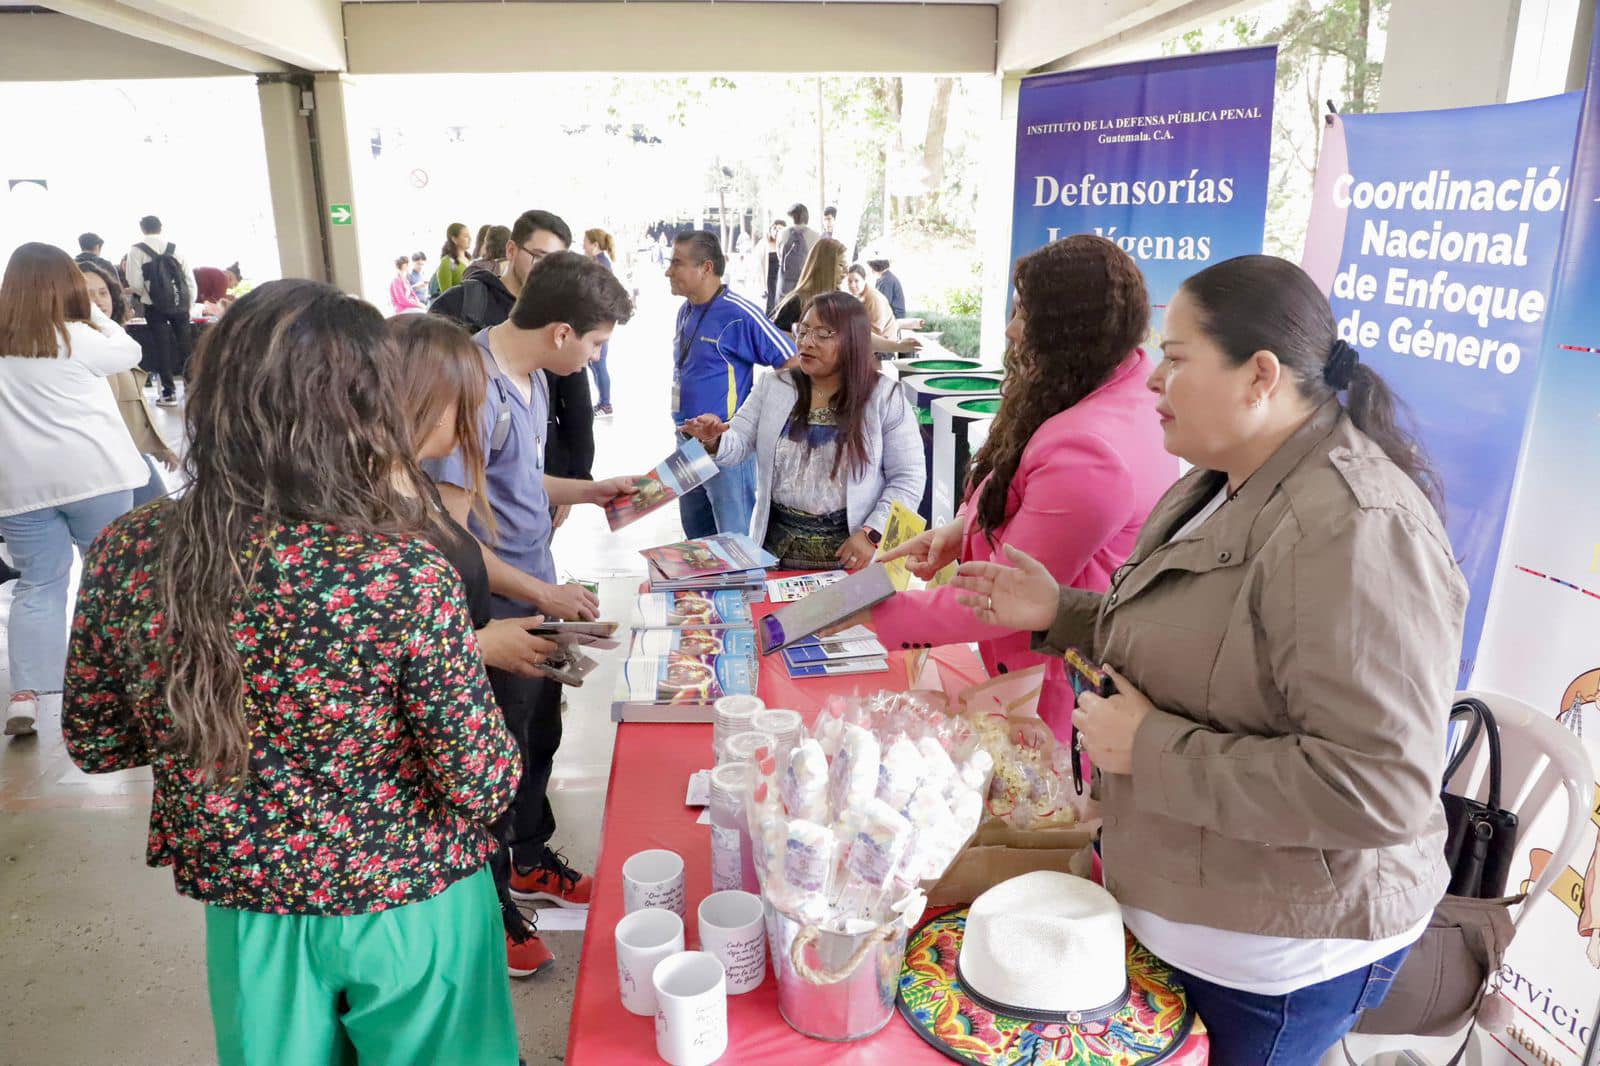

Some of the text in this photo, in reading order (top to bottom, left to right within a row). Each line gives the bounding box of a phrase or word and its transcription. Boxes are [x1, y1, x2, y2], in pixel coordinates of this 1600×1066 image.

[1027, 107, 1262, 135] INSTITUTO DE LA DEFENSA PÚBLICA PENAL
[1153, 129, 1174, 141] C.A.
[1033, 169, 1234, 207] Defensorías
[1333, 166, 1569, 212] Coordinació
[1047, 226, 1212, 266] Igenas
[1361, 220, 1529, 266] Nacional
[1333, 263, 1544, 329] de Enfoque
[1337, 309, 1520, 374] de Género
